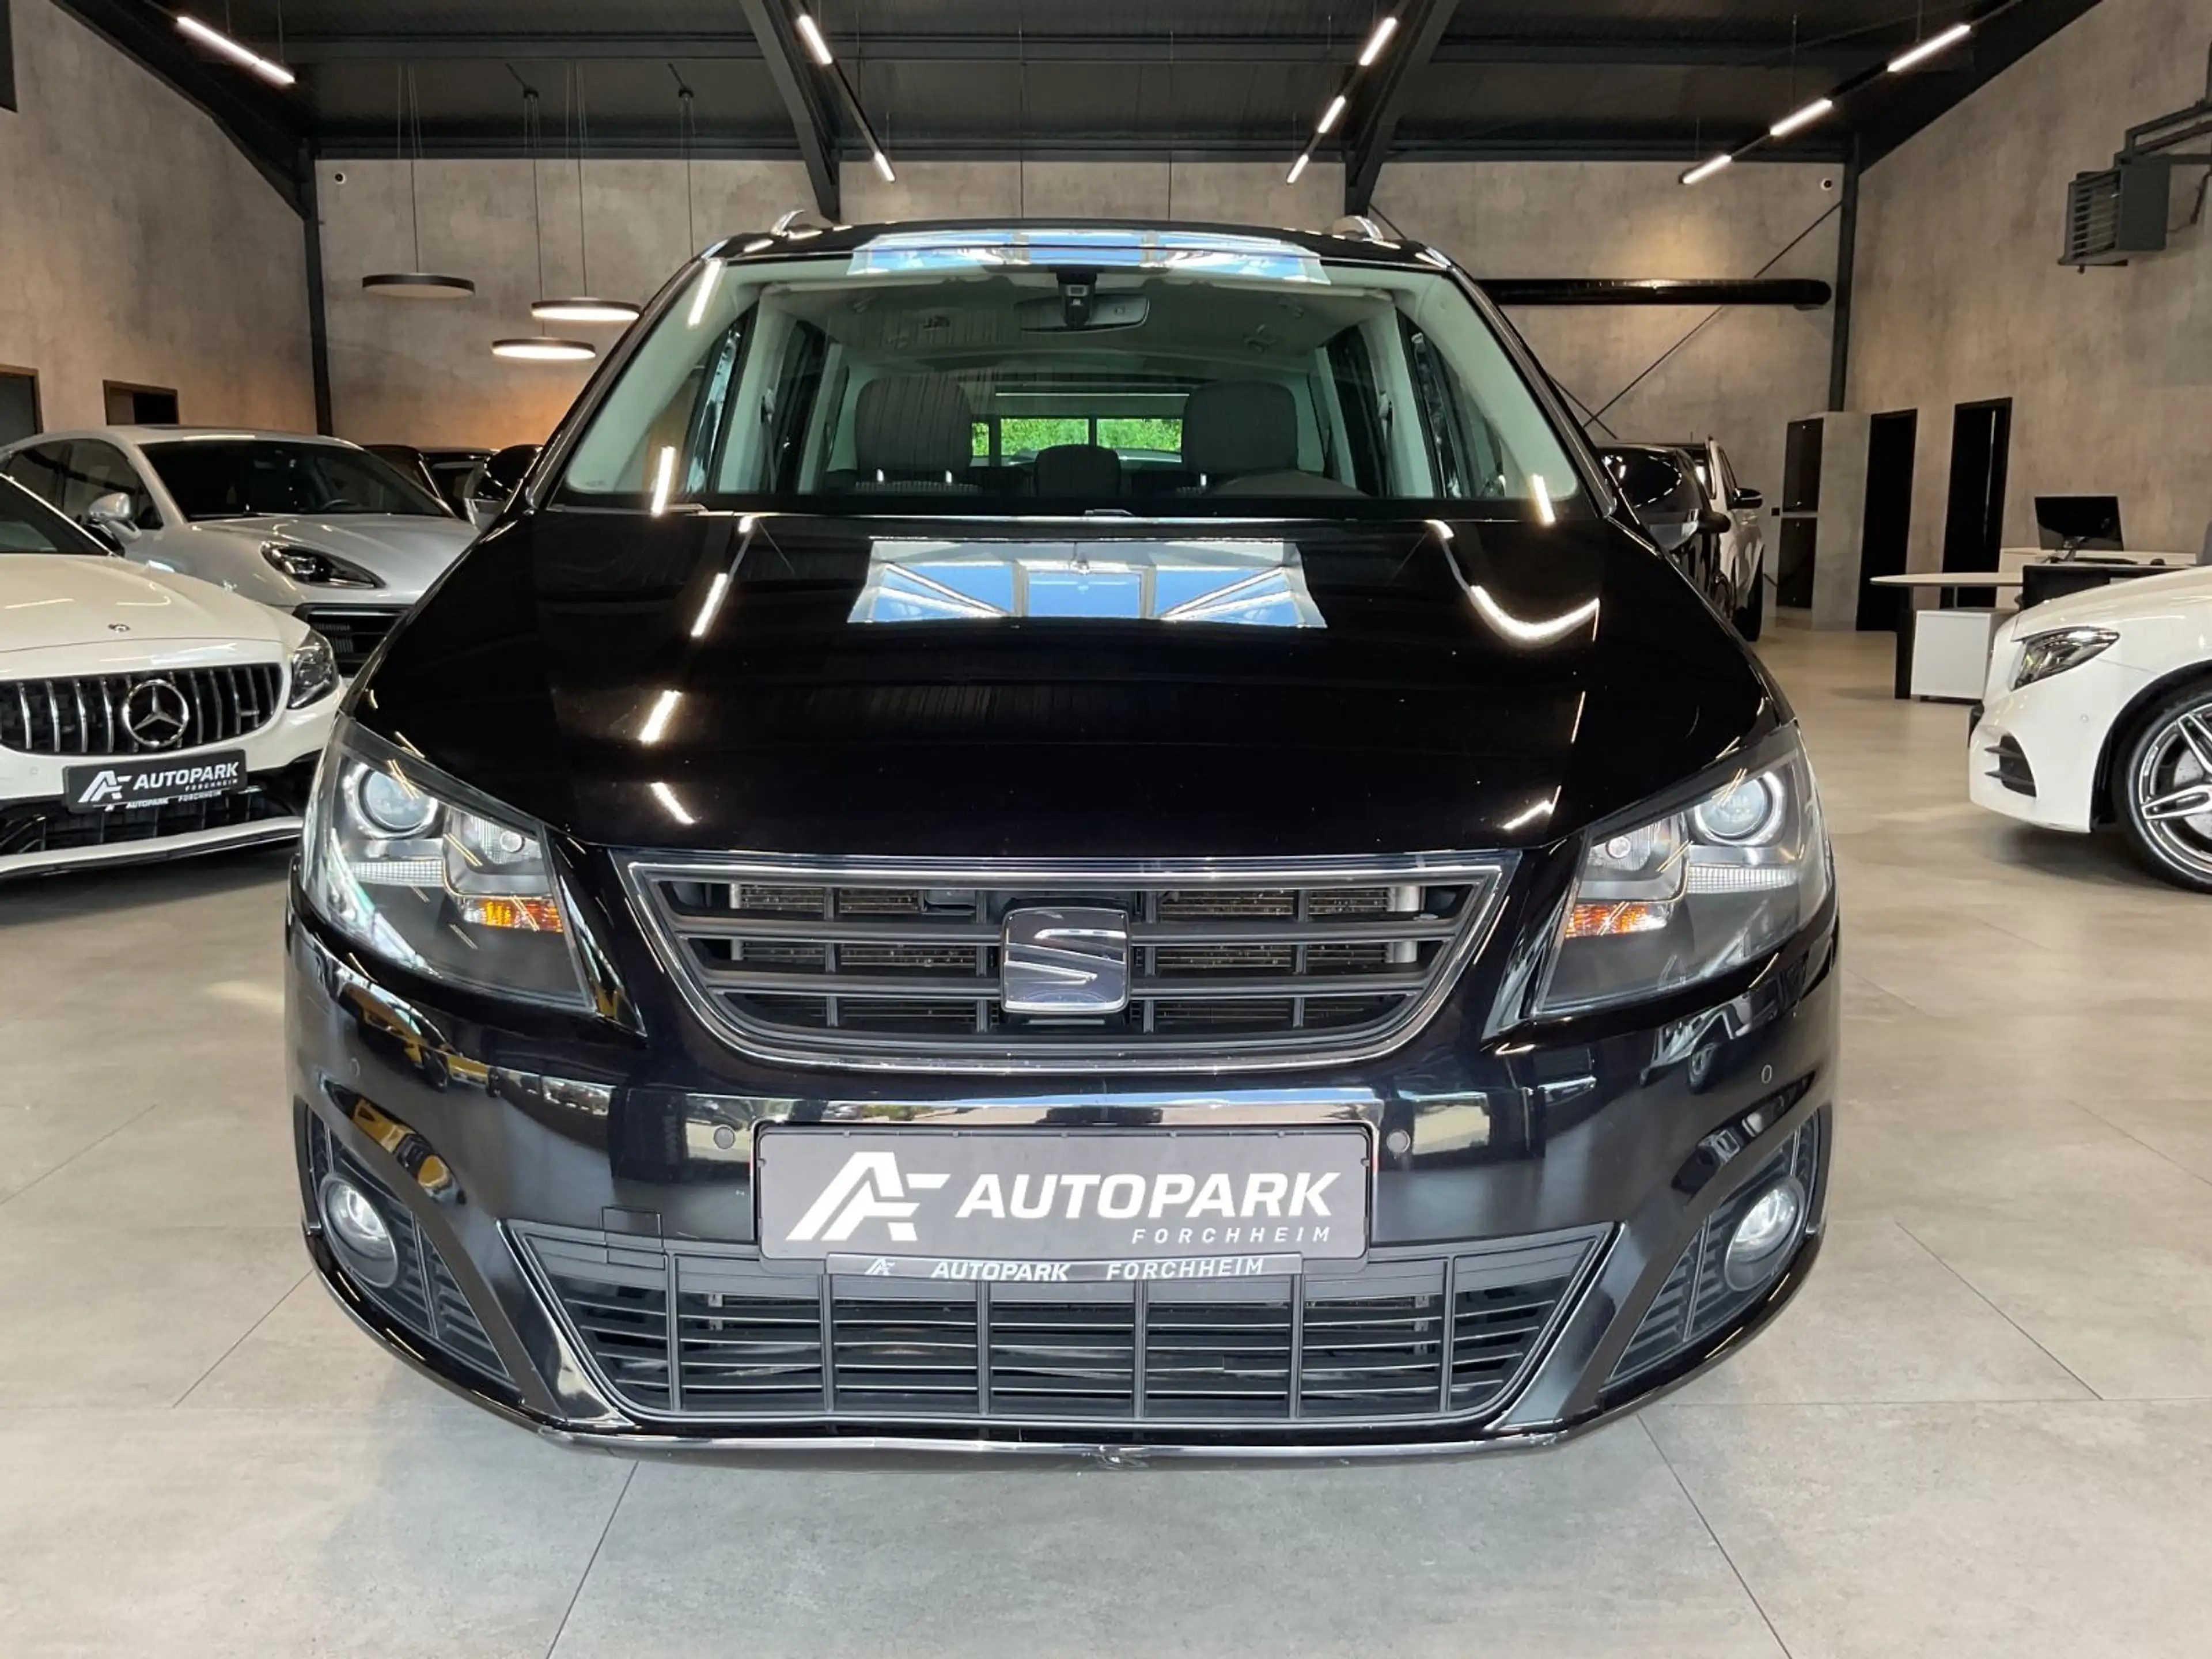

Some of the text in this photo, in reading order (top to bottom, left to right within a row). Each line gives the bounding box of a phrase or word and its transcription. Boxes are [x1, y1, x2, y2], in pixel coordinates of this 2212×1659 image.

[132, 761, 240, 790] AUTOPARK
[954, 1172, 1342, 1219] AUTOPARK
[1131, 1226, 1331, 1245] FORCHHEIM
[930, 1260, 1071, 1282] AUTOPARK
[1105, 1257, 1266, 1281] FORCHHEIM
